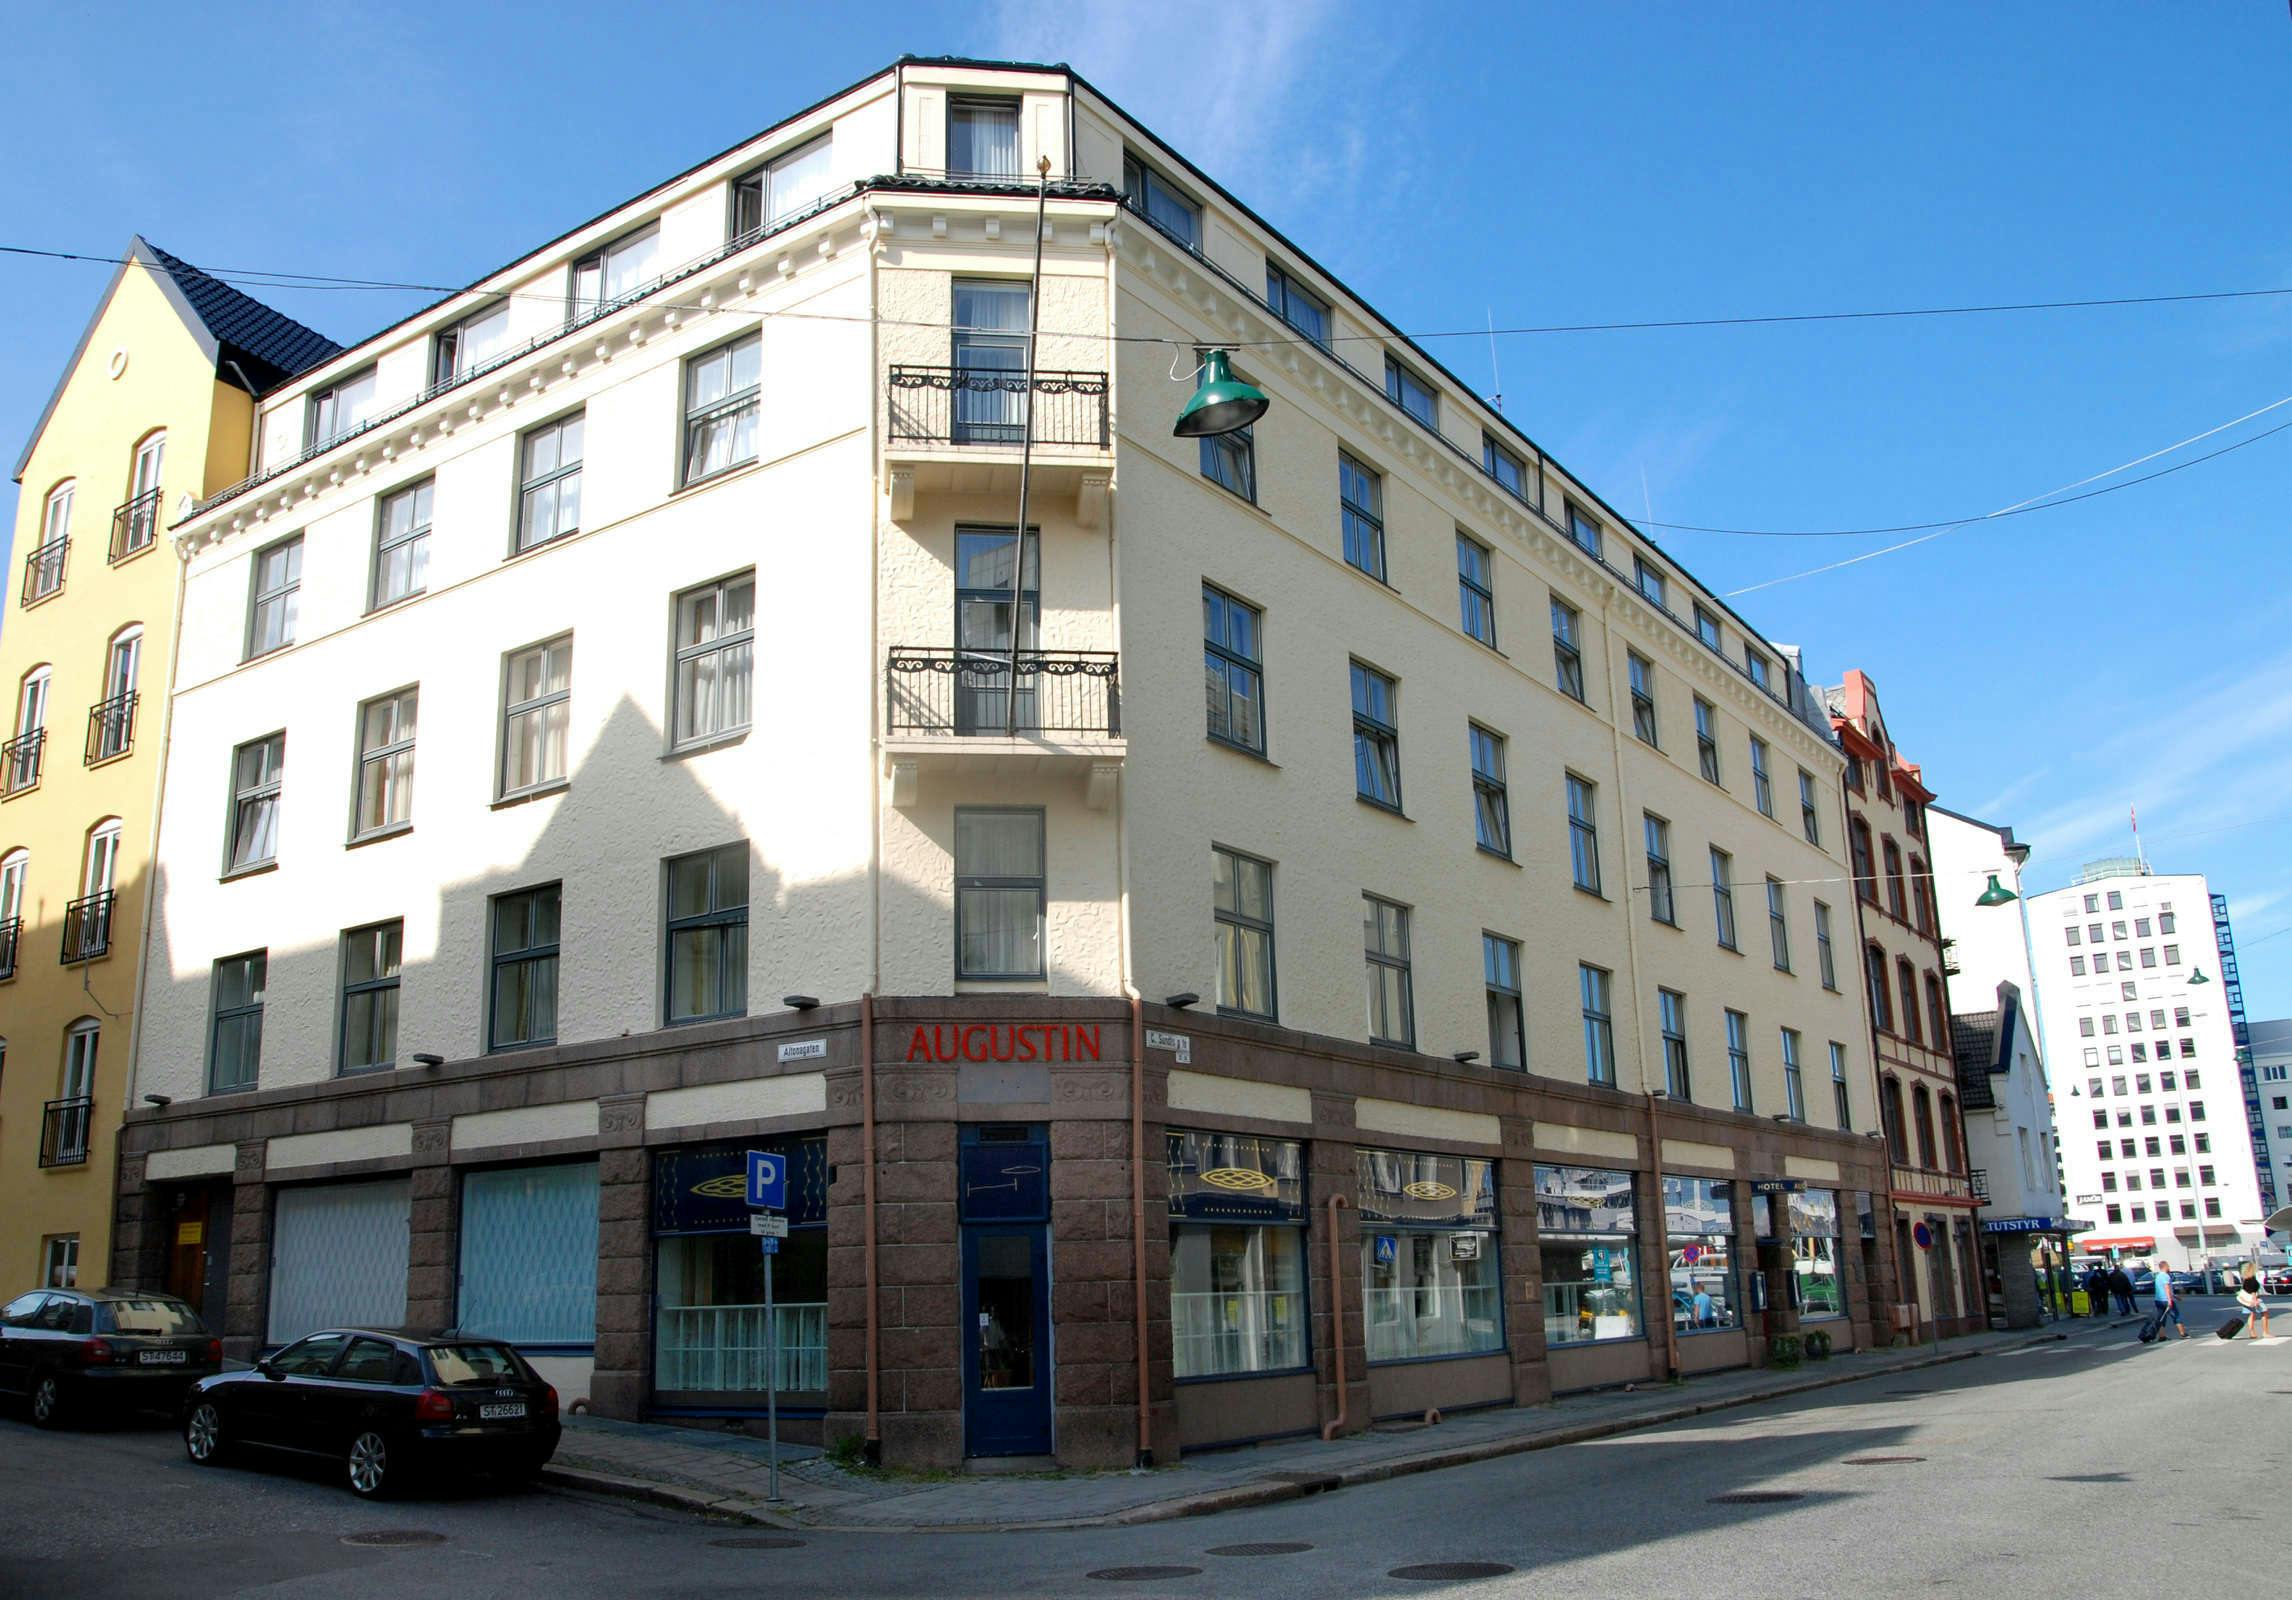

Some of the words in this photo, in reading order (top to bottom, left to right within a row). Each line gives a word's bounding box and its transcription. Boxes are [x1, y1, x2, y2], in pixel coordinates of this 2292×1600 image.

[784, 1044, 819, 1056] Altonagaten
[906, 1024, 1100, 1062] AUGUSTIN
[756, 1159, 776, 1199] P
[1757, 1183, 1785, 1191] HOTEL
